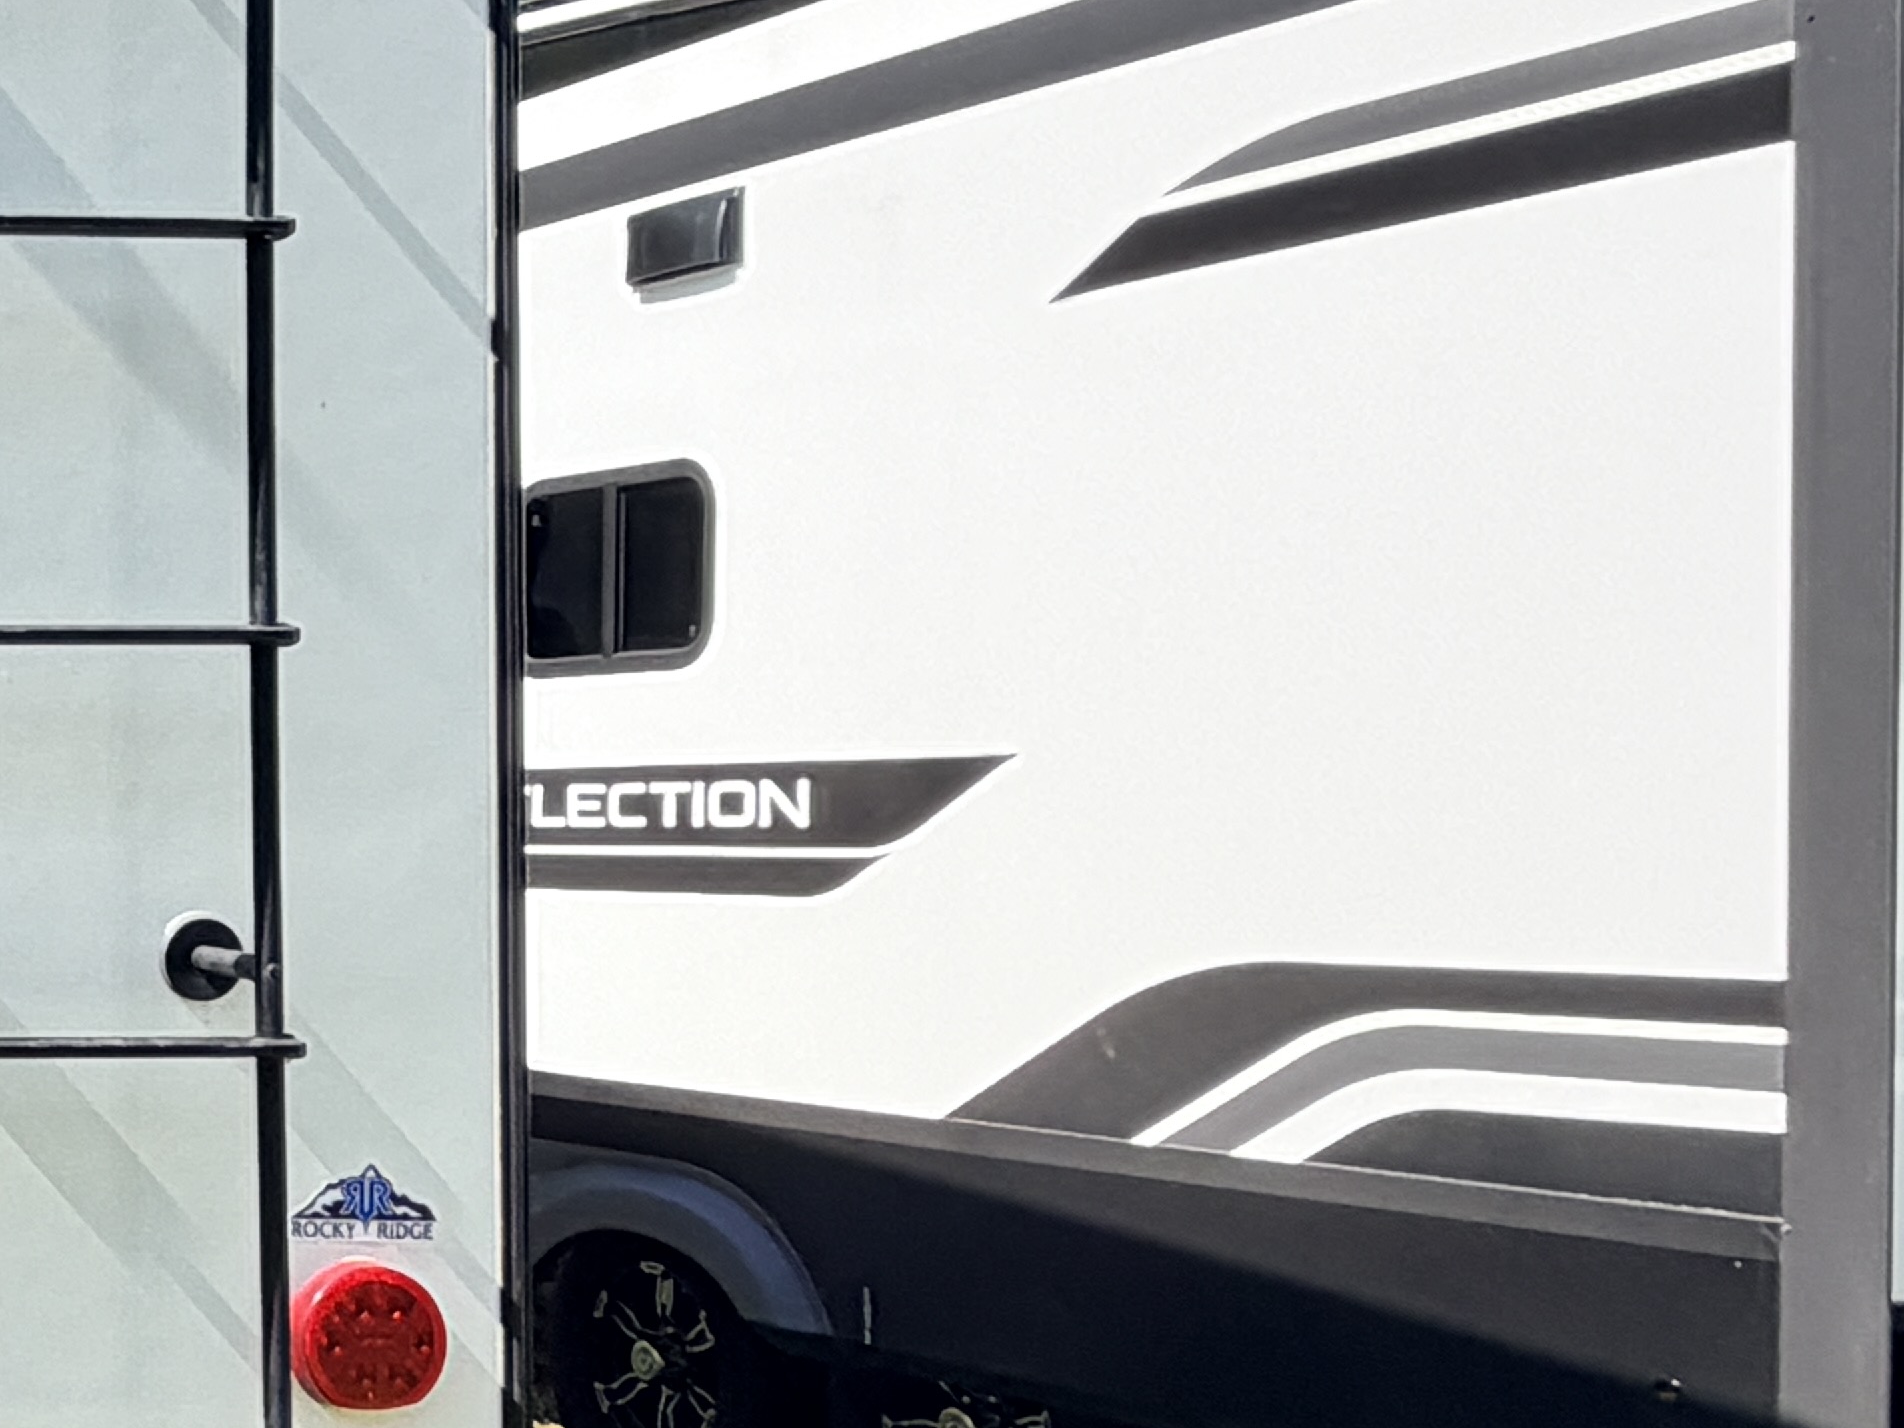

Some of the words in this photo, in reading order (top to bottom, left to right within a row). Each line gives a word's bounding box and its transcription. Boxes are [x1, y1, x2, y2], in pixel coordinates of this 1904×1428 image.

[524, 777, 812, 829] LECTION
[291, 1220, 356, 1239] ROCKY
[376, 1222, 434, 1240] RIDGE
